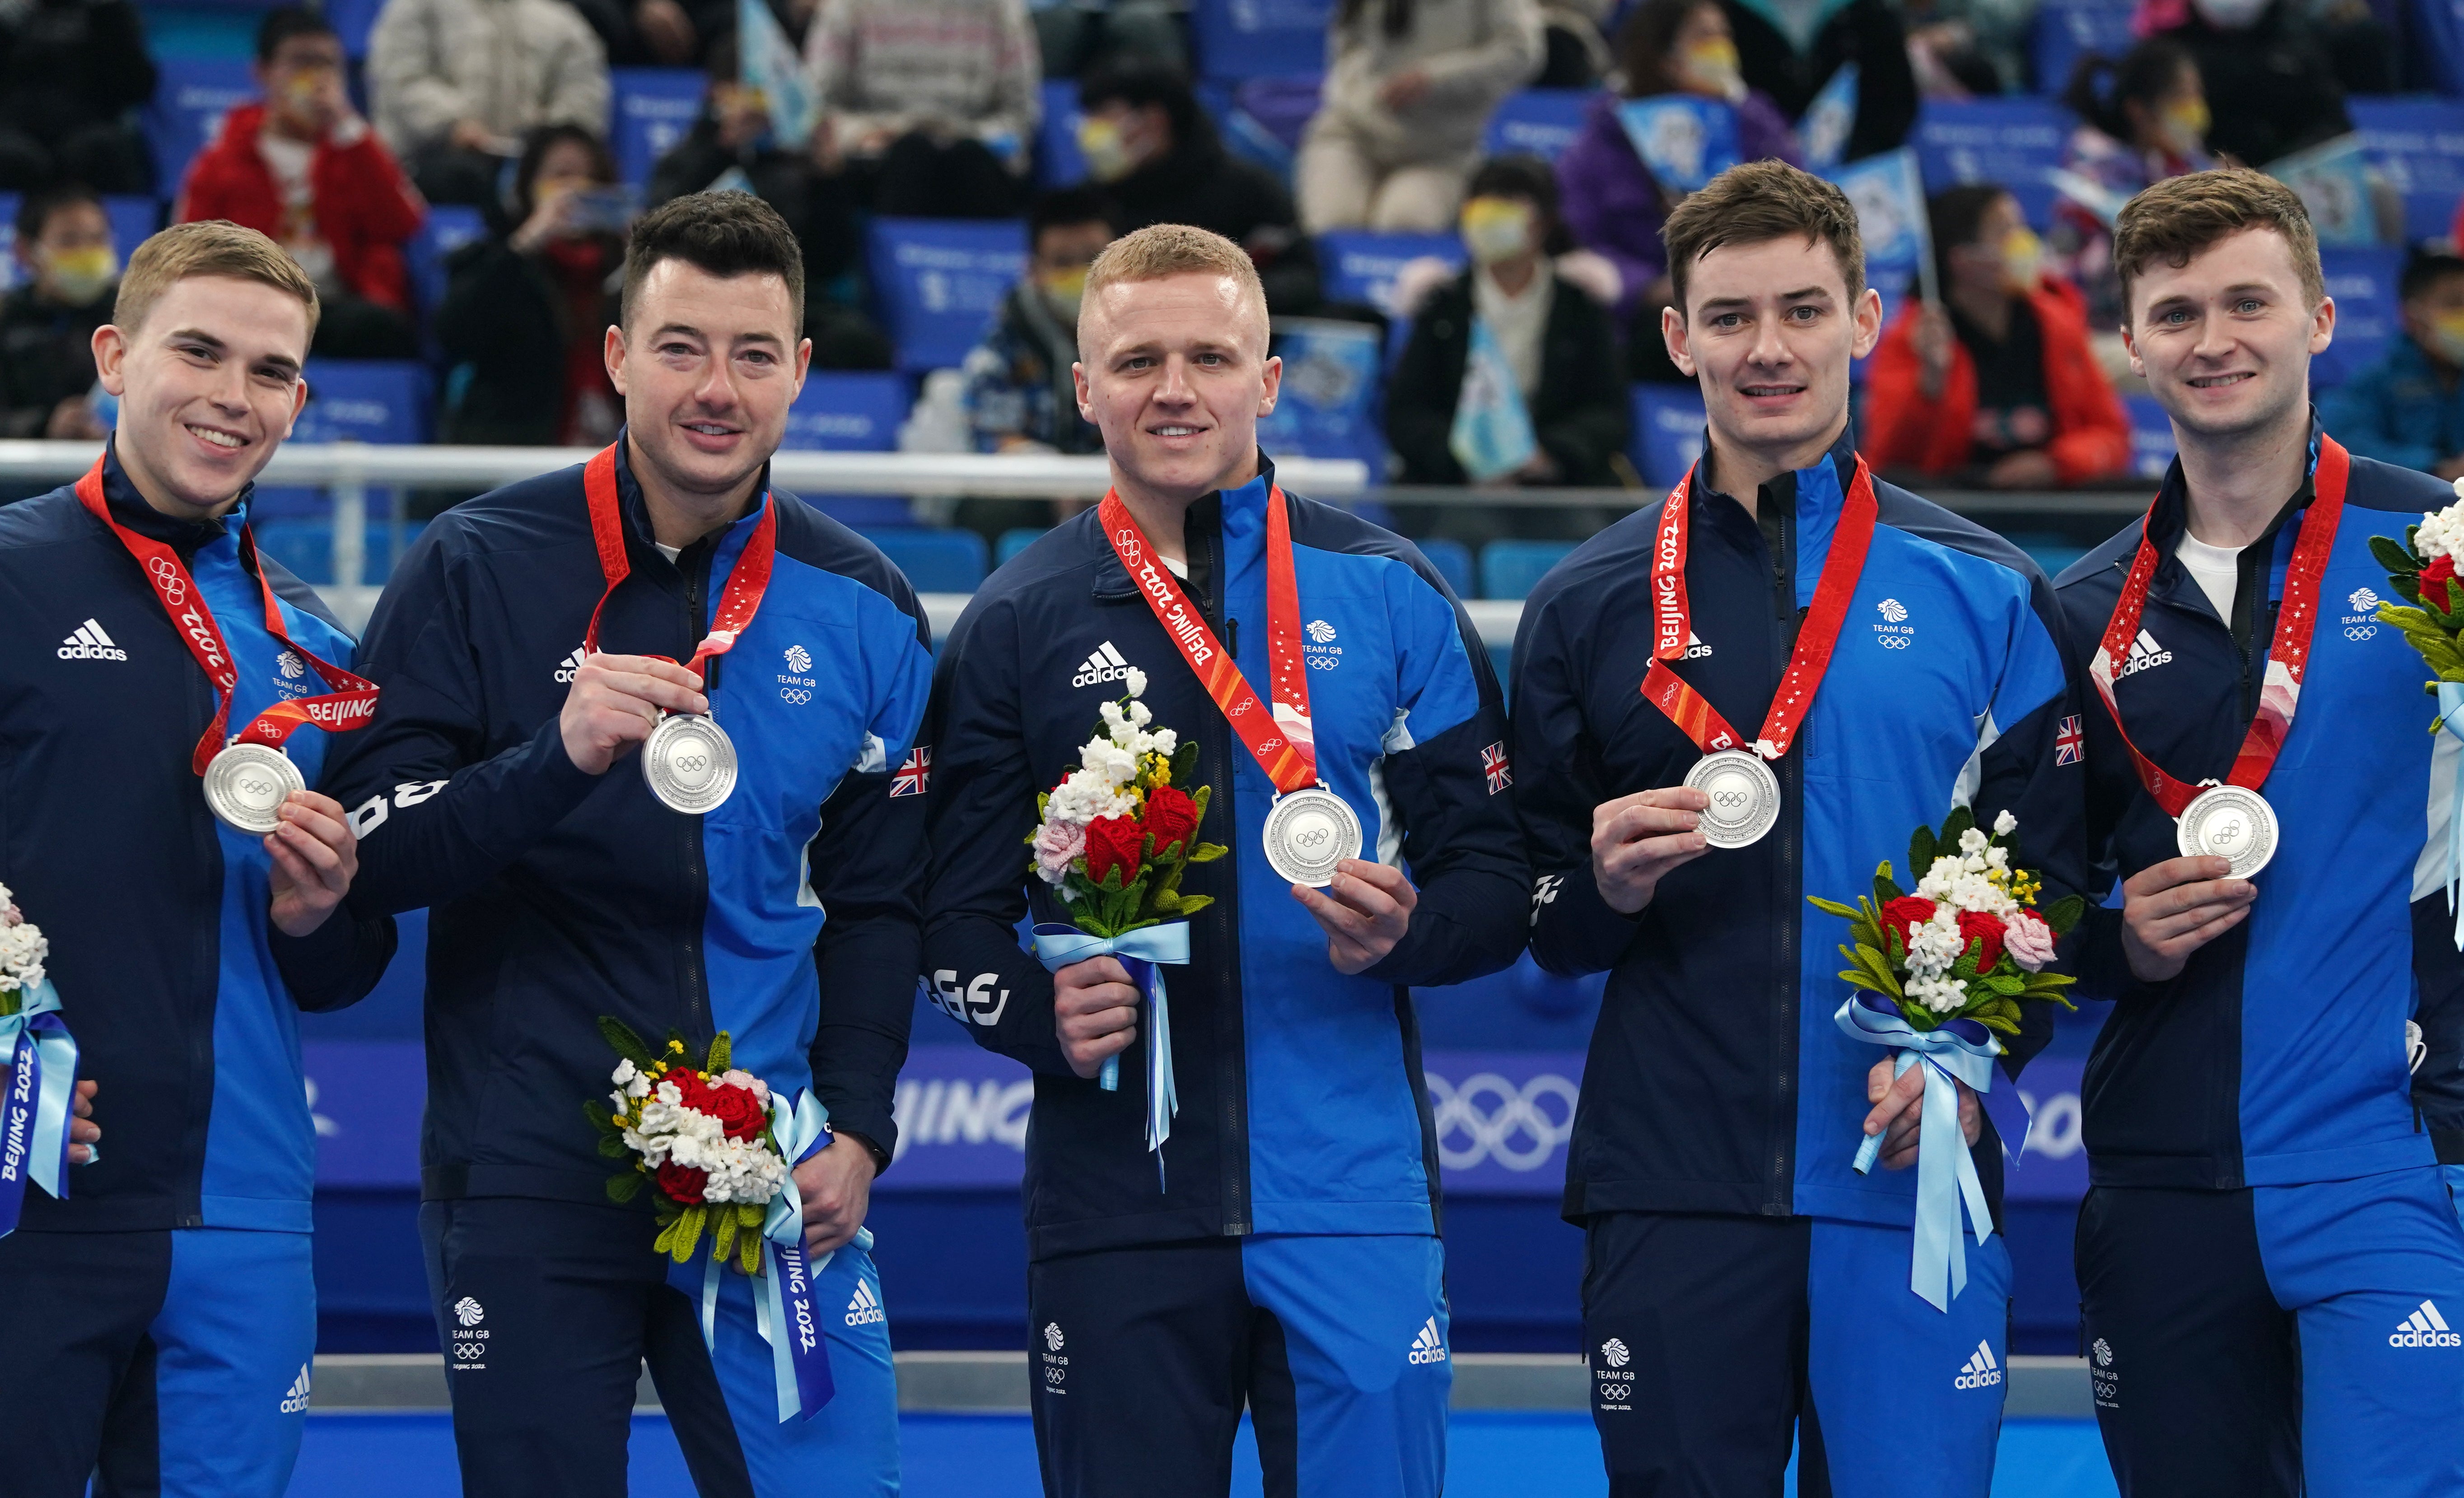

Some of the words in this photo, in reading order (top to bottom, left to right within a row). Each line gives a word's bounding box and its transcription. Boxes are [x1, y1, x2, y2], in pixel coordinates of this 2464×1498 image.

[1659, 517, 1679, 572] 2022
[1140, 558, 1174, 609] 2022
[1658, 576, 1685, 651] BEIJING
[2341, 615, 2366, 624] TEAM
[2368, 614, 2381, 623] G
[182, 604, 225, 667] 2022
[1167, 604, 1213, 667] BEIJING
[1873, 624, 1898, 633] TEAM
[1900, 626, 1914, 634] GB
[57, 643, 127, 661] adidas
[1302, 645, 1327, 653] TEAM
[1329, 647, 1342, 655] GB
[272, 677, 293, 690] TEAM
[294, 684, 307, 694] GB
[777, 675, 801, 685] TEAM
[803, 678, 816, 687] GB
[307, 698, 377, 726] BEIJING
[1744, 809, 1756, 821] Beijing
[1292, 852, 1307, 865] Olympic
[1320, 855, 1333, 864] Games
[14, 1047, 34, 1103] 2022
[1, 1106, 28, 1182] BEIJING
[845, 1306, 884, 1326] adidas
[476, 1330, 490, 1339] GB
[793, 1298, 817, 1355] 2022
[2389, 1330, 2462, 1348] adidas
[1042, 1353, 1056, 1364] TEAM
[1058, 1356, 1069, 1365] GB
[1409, 1346, 1446, 1365] adidas
[1596, 1370, 1620, 1380] TEAM
[1622, 1372, 1635, 1380] GB
[1955, 1369, 2001, 1390] adidas
[2091, 1367, 2105, 1379] TEAM
[2106, 1372, 2118, 1380] GB
[280, 1392, 309, 1414] adida
